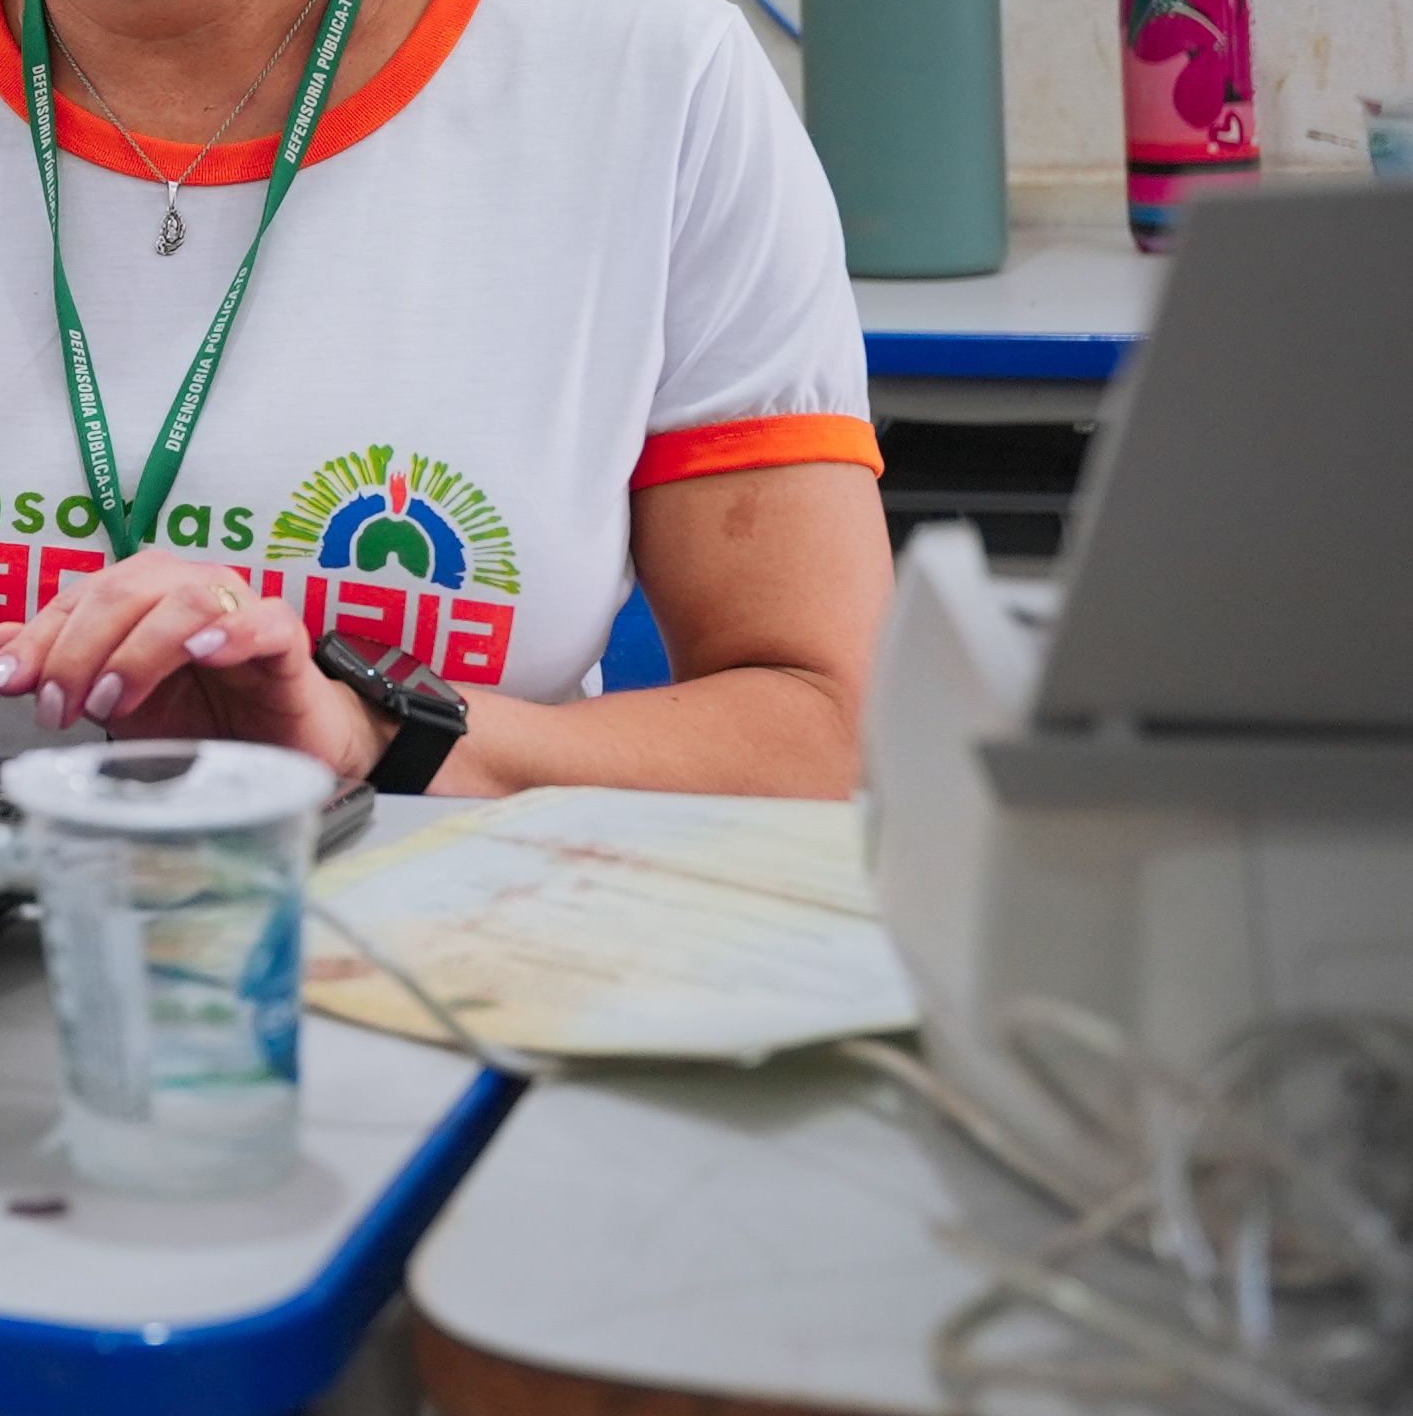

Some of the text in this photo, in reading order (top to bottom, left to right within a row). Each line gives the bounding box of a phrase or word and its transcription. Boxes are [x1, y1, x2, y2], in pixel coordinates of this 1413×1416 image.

[32, 63, 53, 150] DEFENSORIA
[284, 72, 326, 164] DEFENSORIA
[68, 328, 116, 511] DEFENSORIA PÚBLICA-TO
[165, 266, 248, 453] DEFENSORIA PÚBLICA-TO
